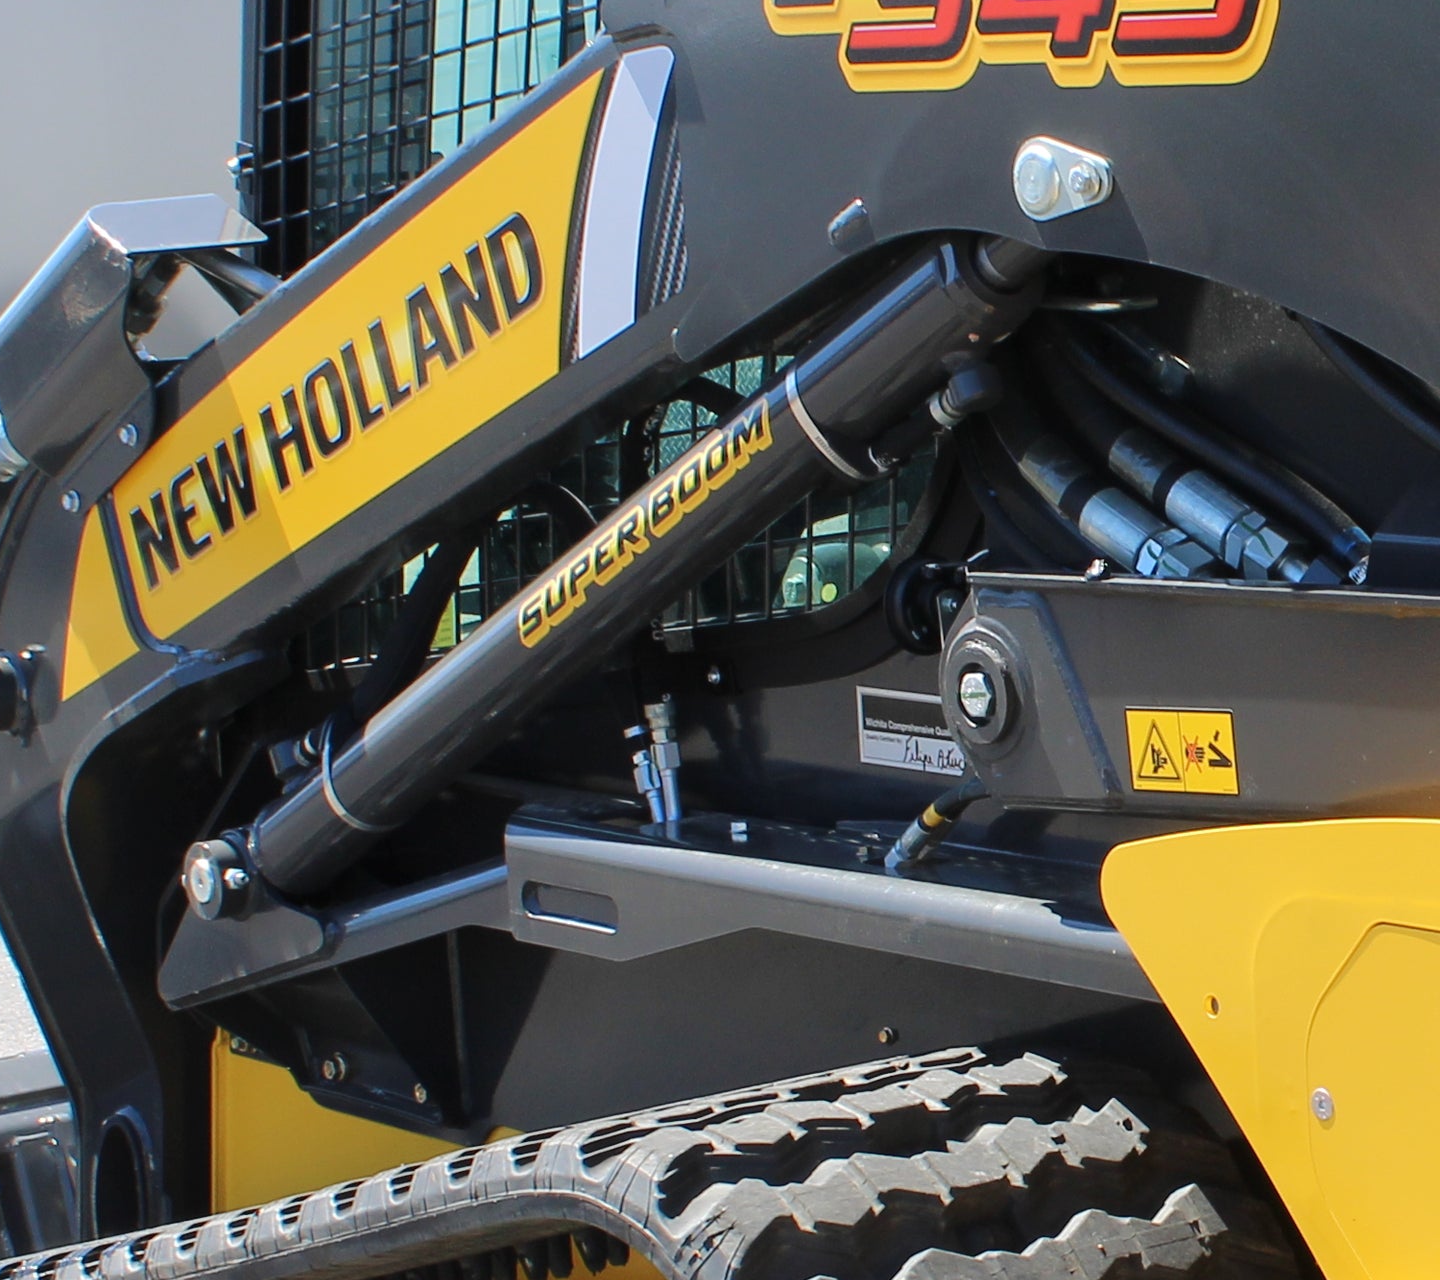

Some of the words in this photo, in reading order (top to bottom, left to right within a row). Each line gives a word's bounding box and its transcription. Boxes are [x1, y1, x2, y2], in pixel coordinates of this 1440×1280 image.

[128, 424, 258, 592] NEW
[259, 212, 545, 494] HOLLAND
[518, 505, 650, 648] SUPER
[649, 399, 773, 538] BOOM
[888, 720, 935, 736] Comprehensive
